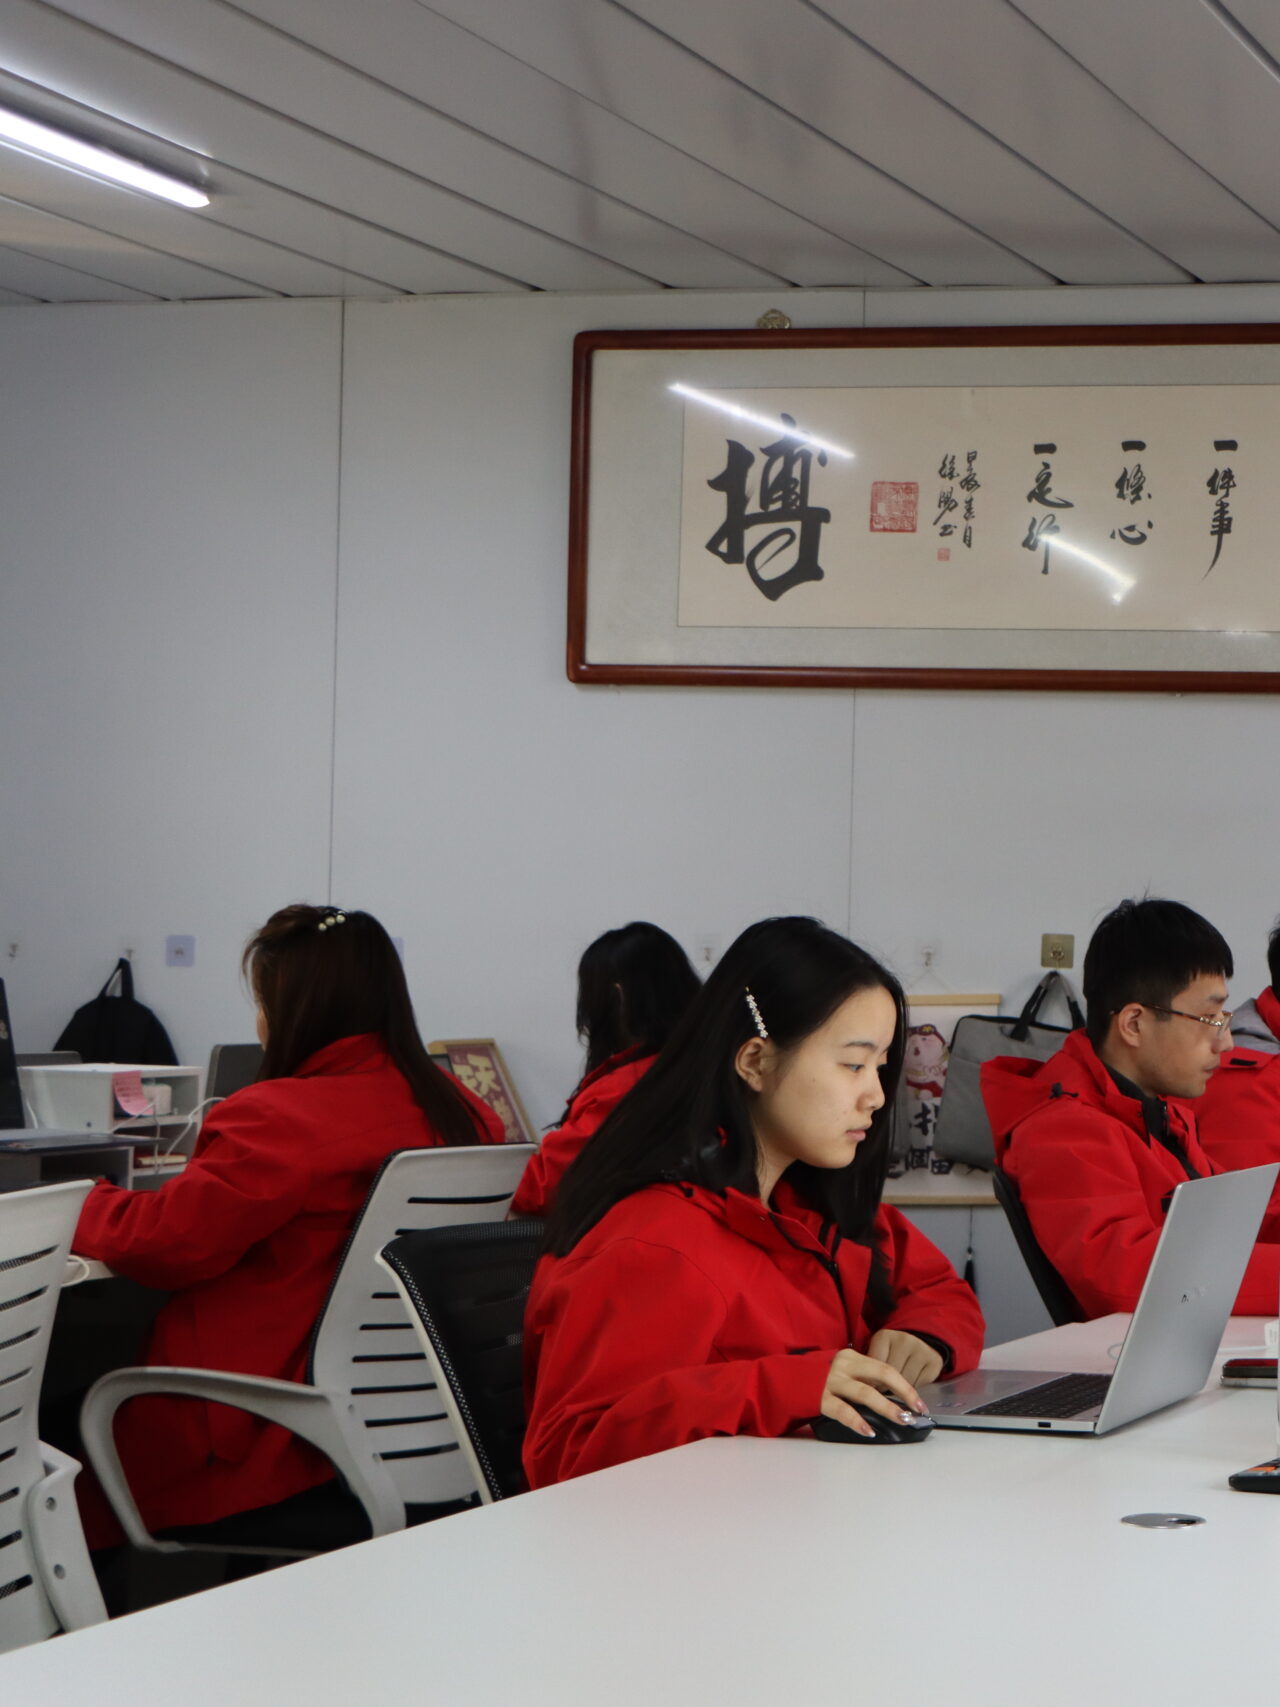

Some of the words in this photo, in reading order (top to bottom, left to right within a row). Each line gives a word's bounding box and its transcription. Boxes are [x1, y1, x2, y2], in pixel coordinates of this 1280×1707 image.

[1021, 442, 1074, 575] 一定行
[1201, 439, 1239, 581] 一件事
